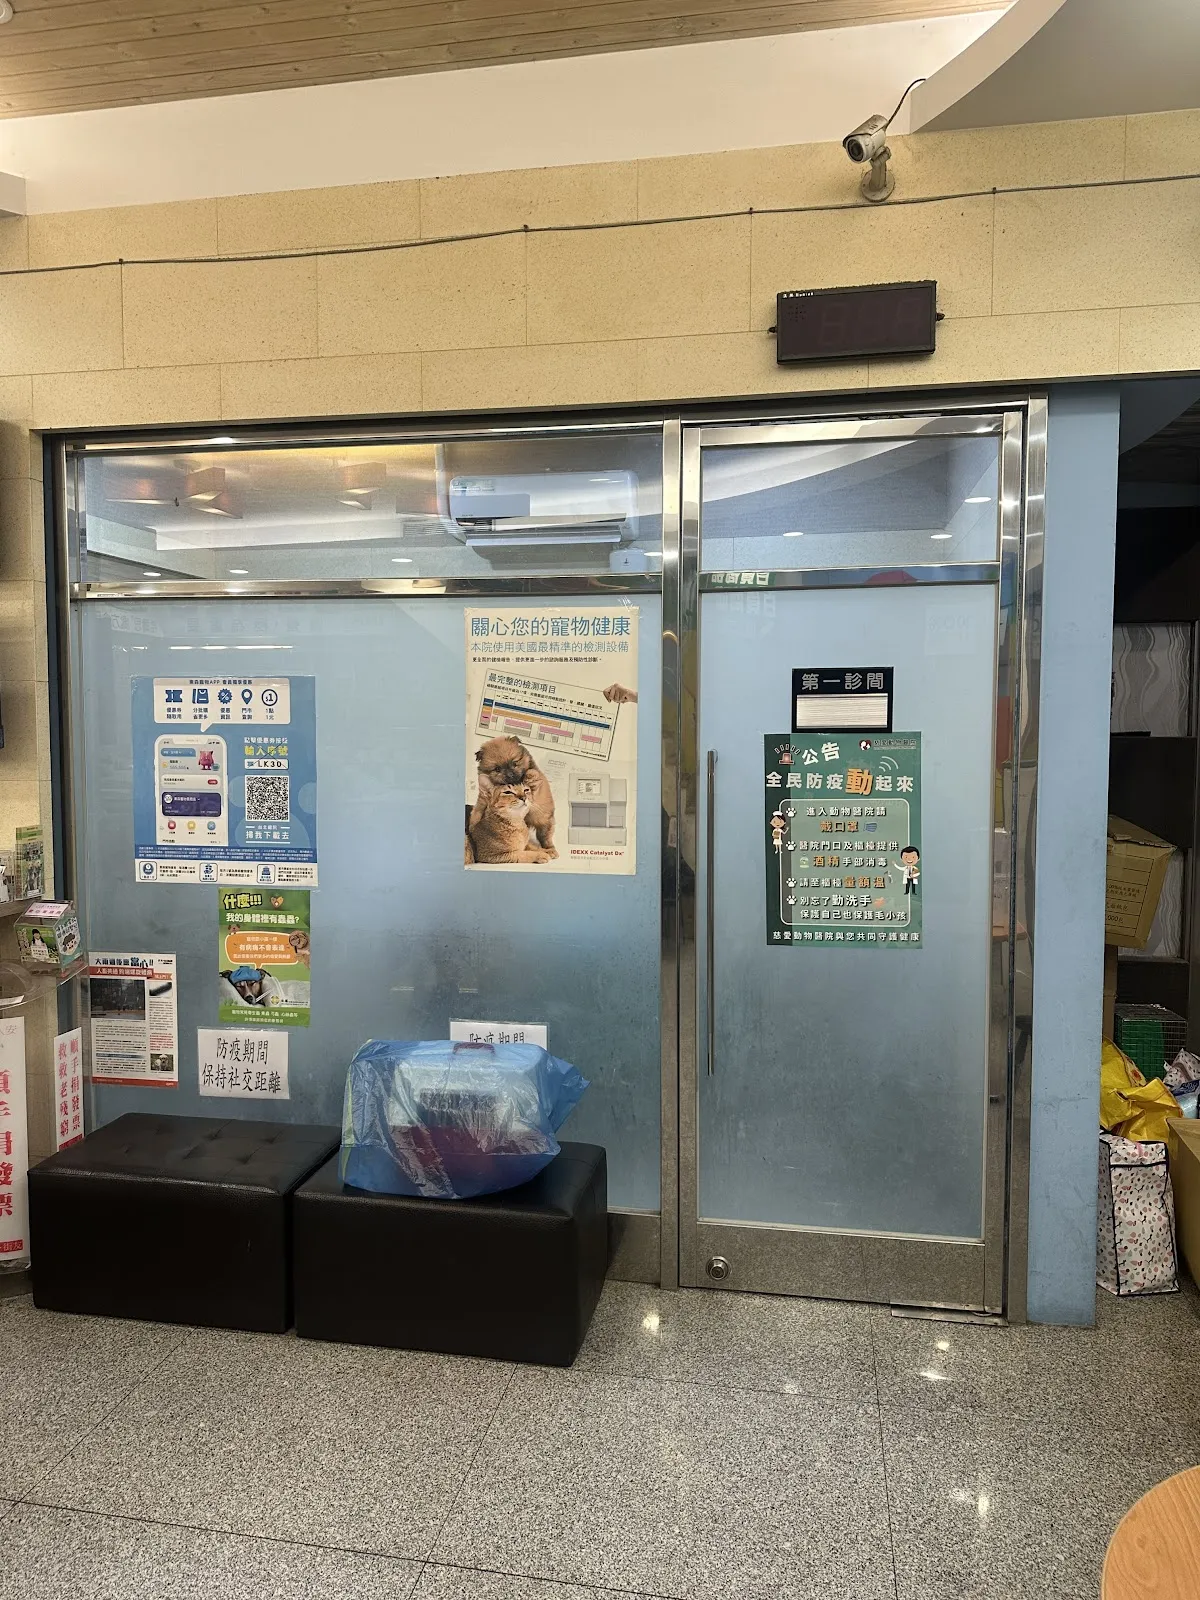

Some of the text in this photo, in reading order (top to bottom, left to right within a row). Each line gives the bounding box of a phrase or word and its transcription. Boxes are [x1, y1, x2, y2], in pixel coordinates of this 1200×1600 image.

[471, 615, 630, 637] 關心您的寵物健康
[470, 641, 629, 653] 本院使用美國最精準的檢測設備
[488, 672, 557, 695] 最完整的檢測項目
[801, 672, 884, 691] 第一診間
[244, 745, 289, 756] 輸入序號
[801, 741, 840, 766] 公告
[257, 760, 282, 768] LK30
[766, 767, 914, 796] 全民防疫動起來
[806, 806, 887, 817] 進入動物醫院請
[820, 821, 859, 833] 戴口罩
[245, 830, 290, 840] 掃我下載去
[799, 840, 899, 851] 醫院門口及櫃檯提供
[812, 855, 888, 868] 酒精手部消毒
[799, 876, 886, 889] 請至櫃檯量額溫
[223, 893, 263, 910] 什麼!!!
[799, 894, 873, 907] 別忘了勤洗手
[799, 909, 908, 921] 保護自己也保護毛小孩
[772, 930, 920, 942] 慈愛動物醫院與您共同守護健康
[216, 1037, 269, 1065] 防疫期間
[69, 1036, 81, 1131] 順手捐發票
[201, 1062, 281, 1094] 保持社交距離
